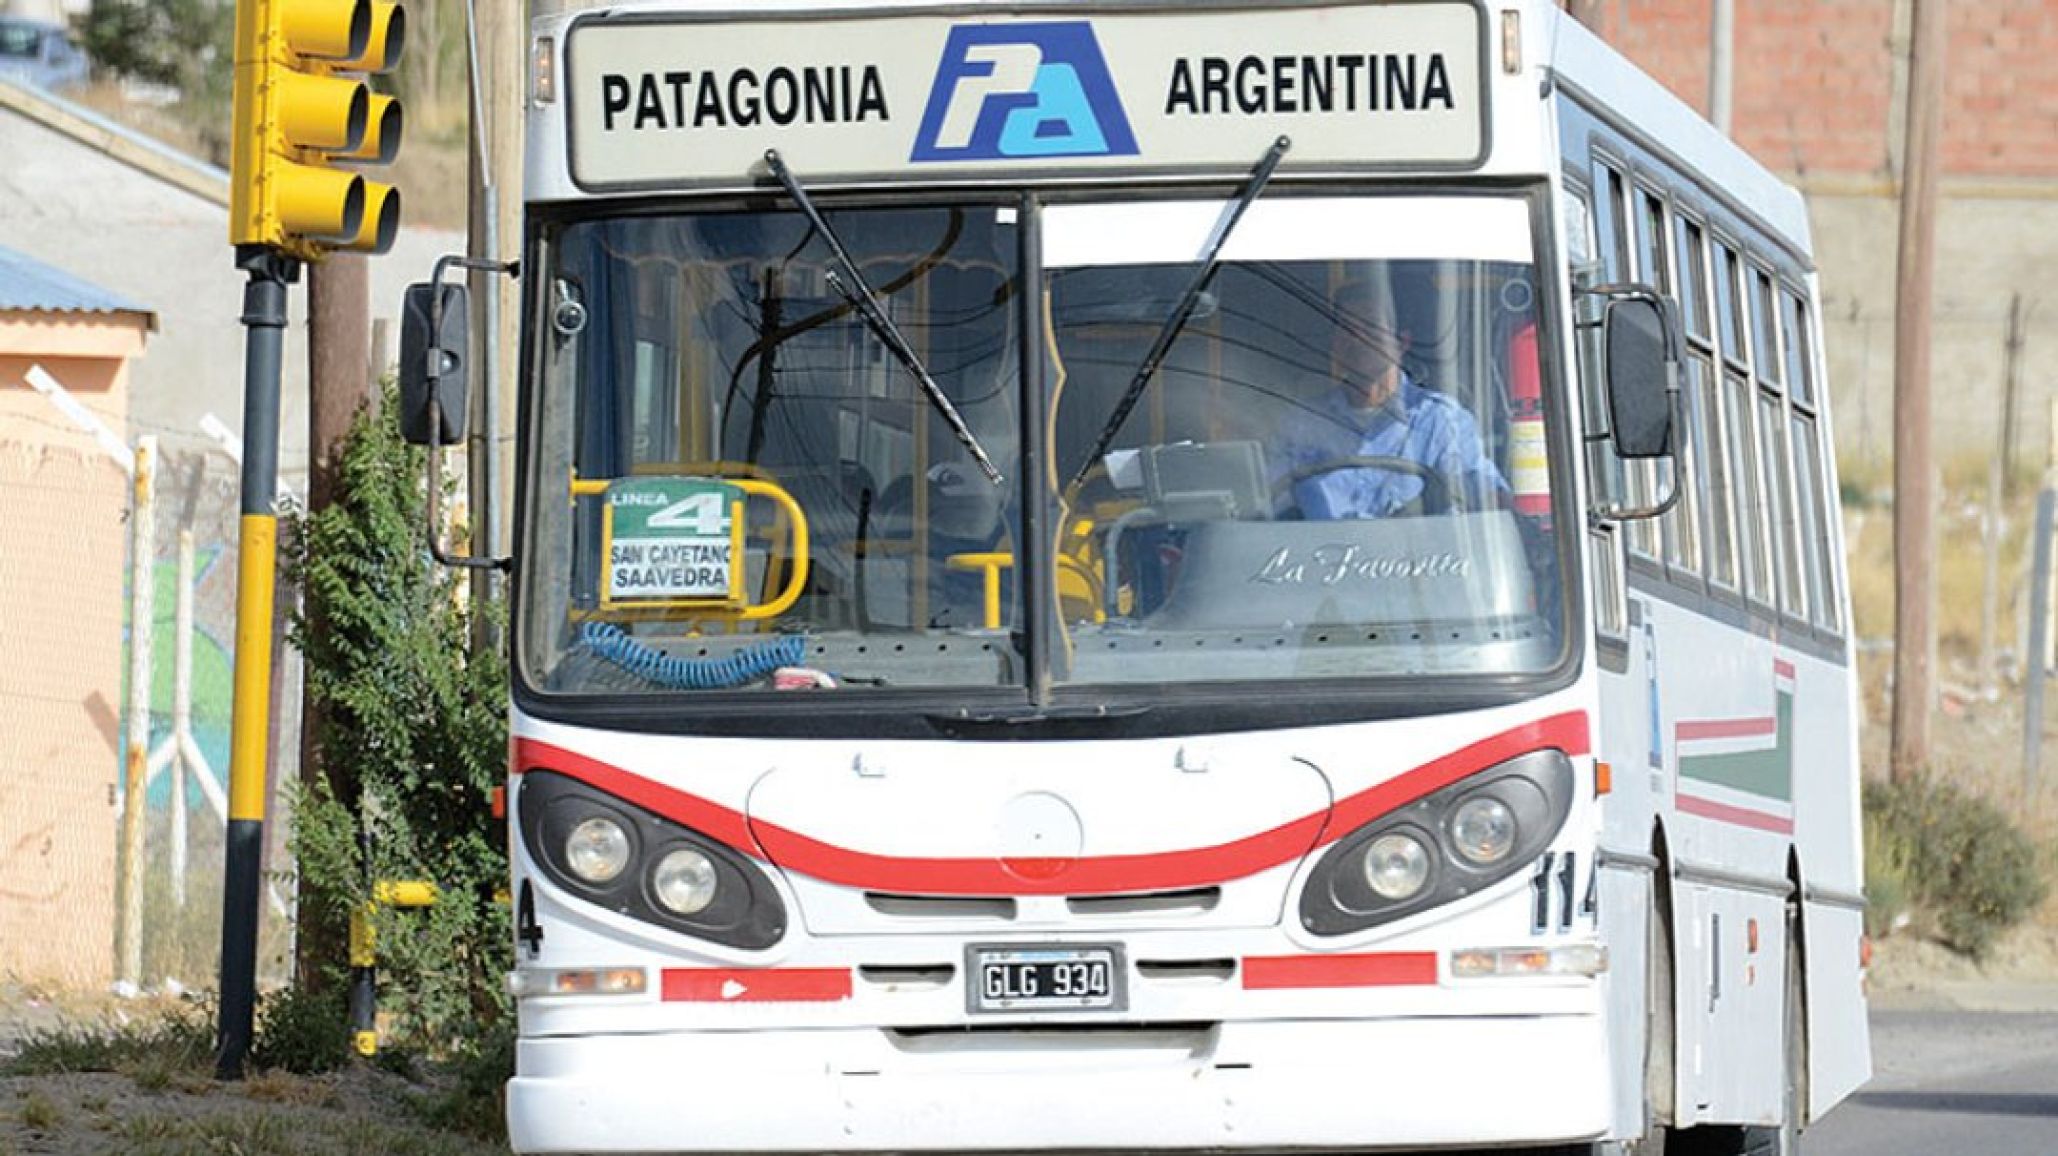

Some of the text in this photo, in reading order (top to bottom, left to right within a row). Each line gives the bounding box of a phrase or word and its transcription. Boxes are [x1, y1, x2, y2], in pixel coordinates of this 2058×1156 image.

[602, 65, 889, 131] PATAGONIA
[1165, 53, 1454, 115] ARGENTINA
[611, 492, 668, 506] LINEA
[647, 492, 732, 535] 4
[611, 544, 643, 564] SAN
[1249, 547, 1304, 583] La
[615, 567, 727, 588] SAAVEDRA
[986, 963, 1105, 995] GLG 934
